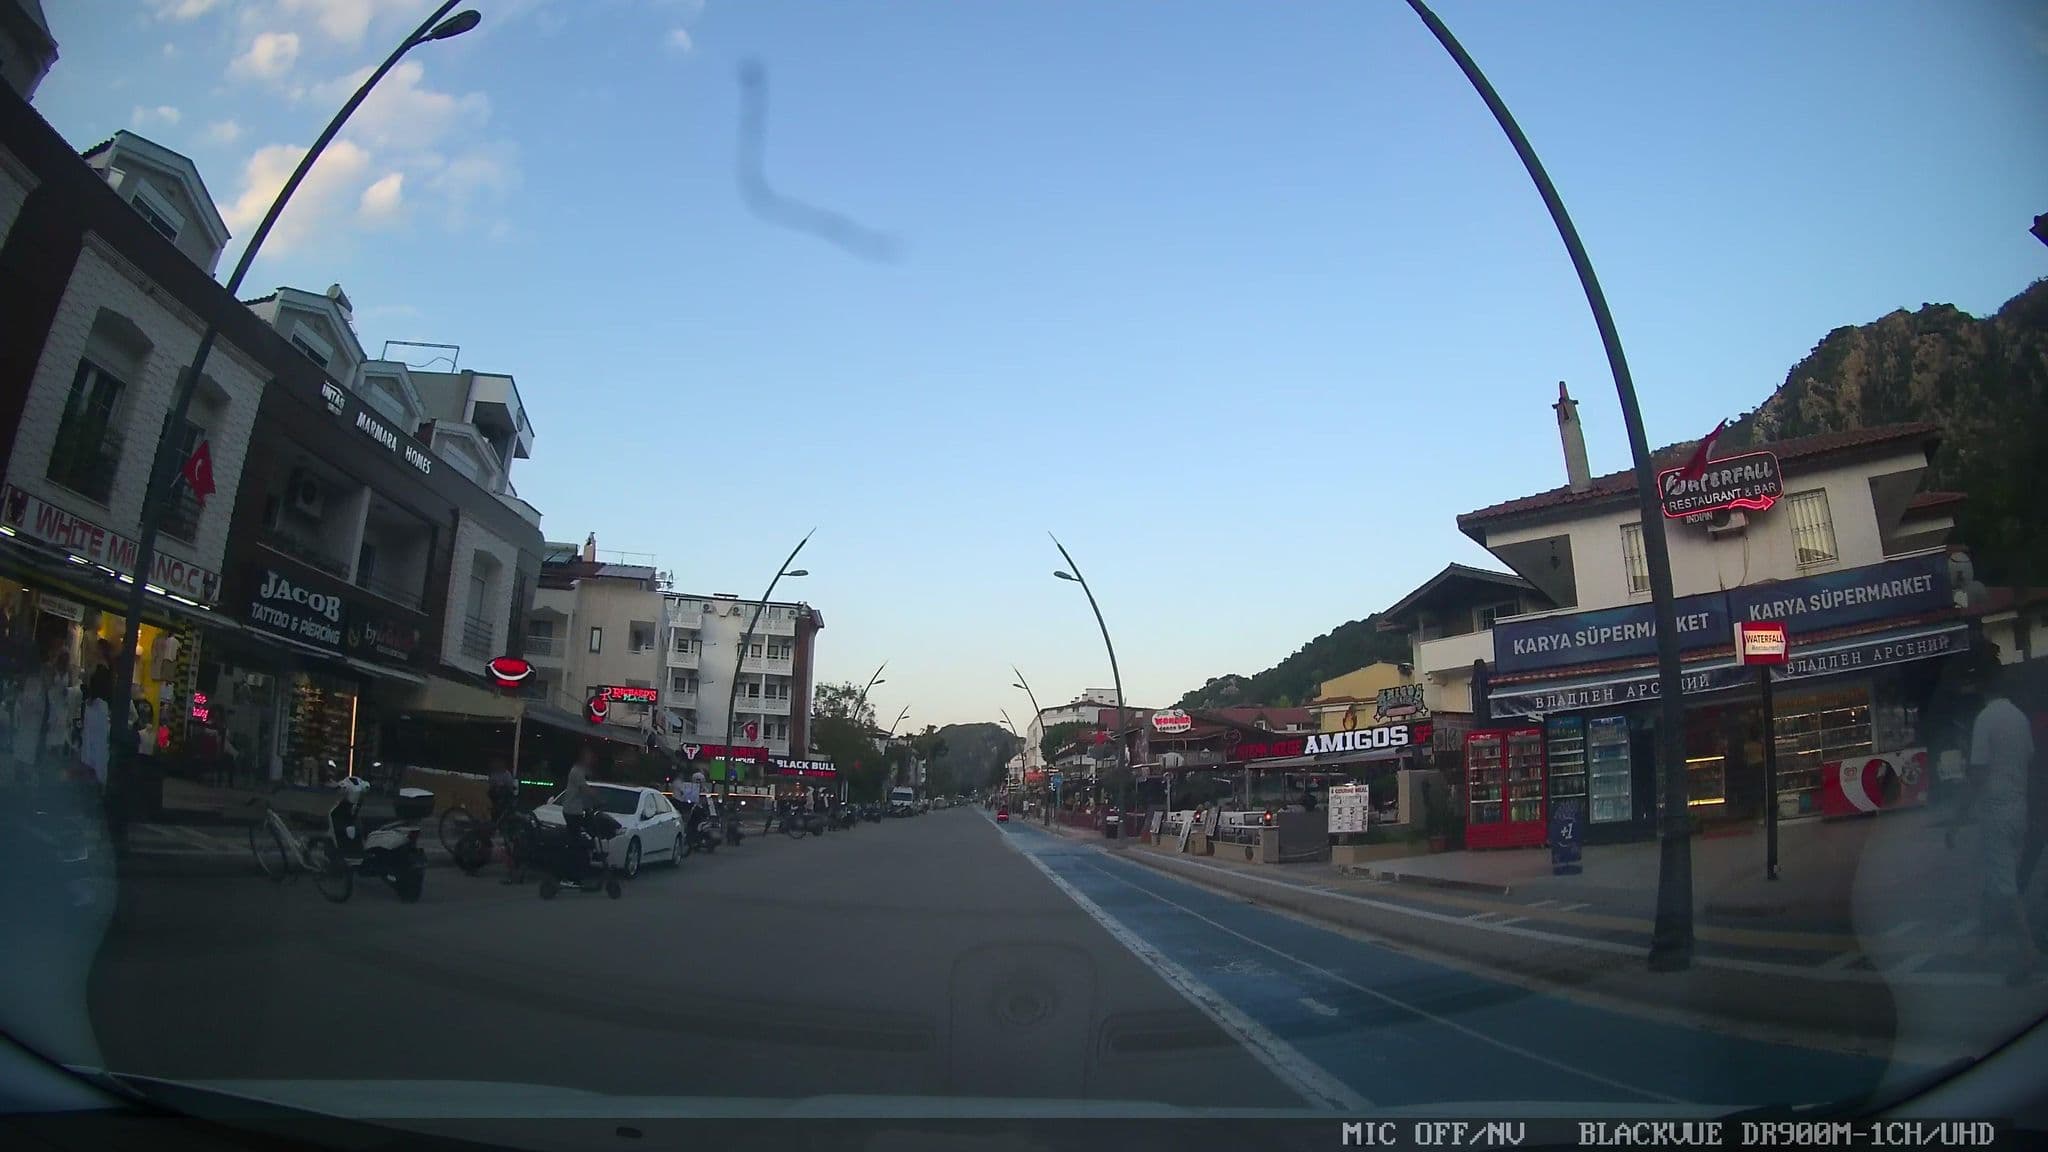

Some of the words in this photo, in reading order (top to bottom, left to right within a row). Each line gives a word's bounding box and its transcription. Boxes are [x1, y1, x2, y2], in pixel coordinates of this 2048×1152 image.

[356, 411, 398, 452] MARMARA
[405, 445, 432, 474] HOMES
[1669, 488, 1741, 512] RESTAURANT
[1744, 485, 1753, 497] &
[1754, 481, 1777, 496] BAR
[1686, 511, 1713, 525] INDIAN
[260, 569, 341, 622] JACOB
[1750, 597, 1807, 621] KARYA
[1810, 575, 1932, 613] SÜPERMARKET
[251, 601, 289, 628] TATTOO
[1514, 632, 1572, 656] KARYA
[1575, 612, 1709, 648] SÜPERMAKET
[1746, 634, 1784, 643] WATERFALL
[1786, 652, 1862, 674] ВЛАДЛЕН
[1874, 635, 1951, 661] АРСЕНИЙ
[1535, 688, 1614, 709] ВЛАДЛЕН
[1627, 674, 1710, 698] АРСИЙ
[1304, 725, 1409, 755] AMIGOS
[777, 759, 809, 770] BLACK
[811, 761, 837, 772] BULL
